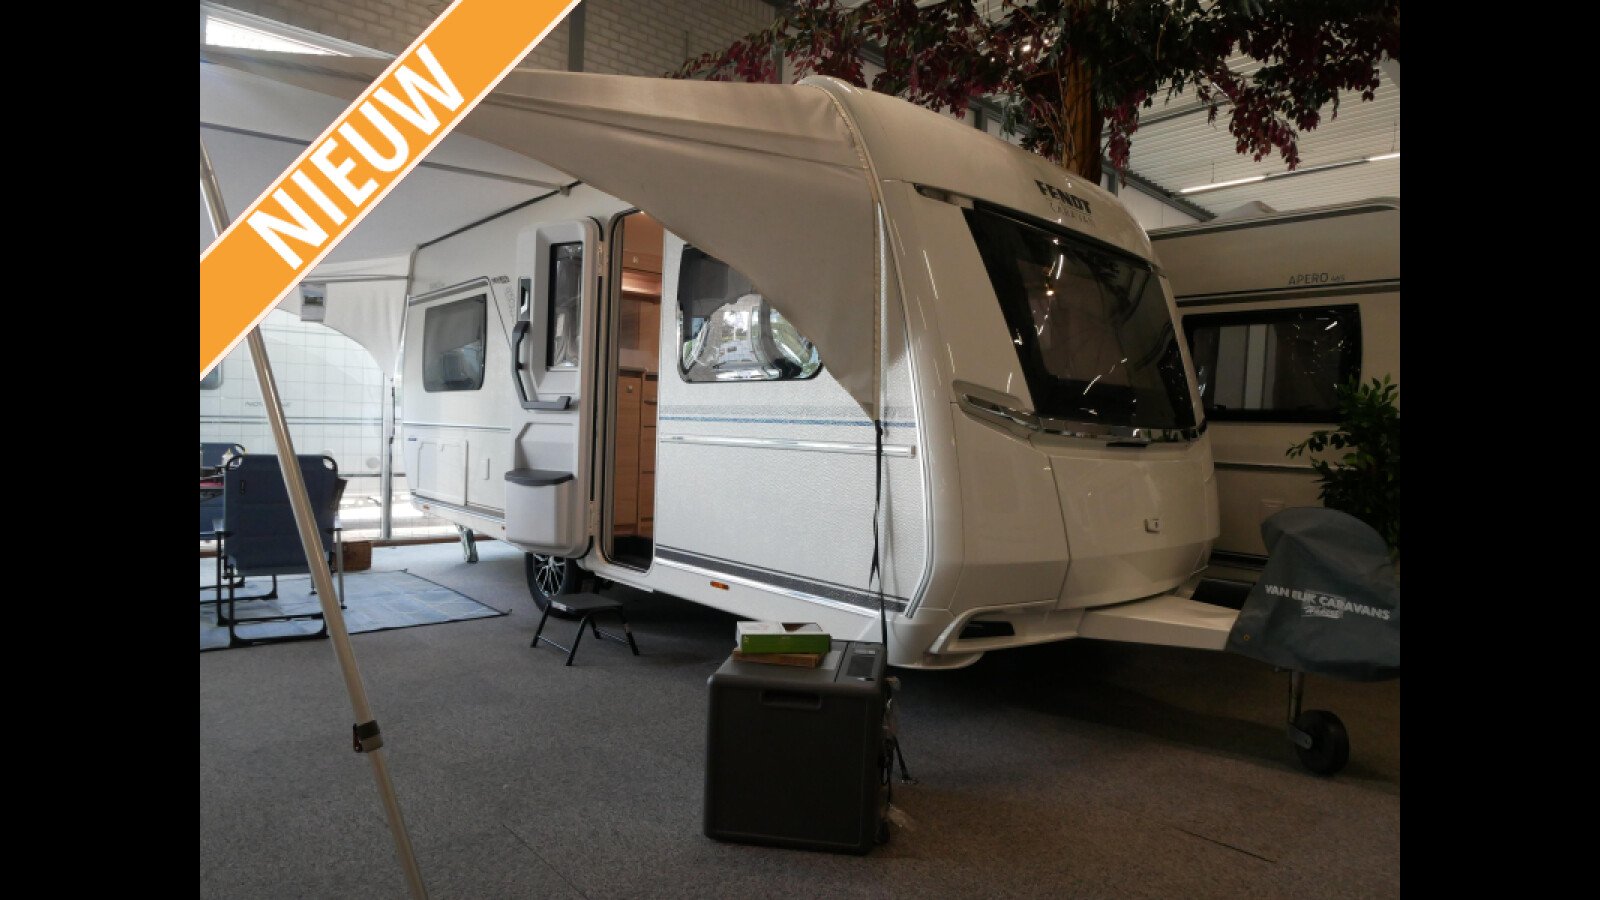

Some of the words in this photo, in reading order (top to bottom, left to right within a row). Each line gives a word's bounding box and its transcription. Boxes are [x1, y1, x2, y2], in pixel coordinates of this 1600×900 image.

[1034, 179, 1092, 214] FENDT
[1288, 272, 1329, 286] APERO
[1264, 584, 1290, 598] VAN
[1319, 596, 1391, 620] CARAVANS
